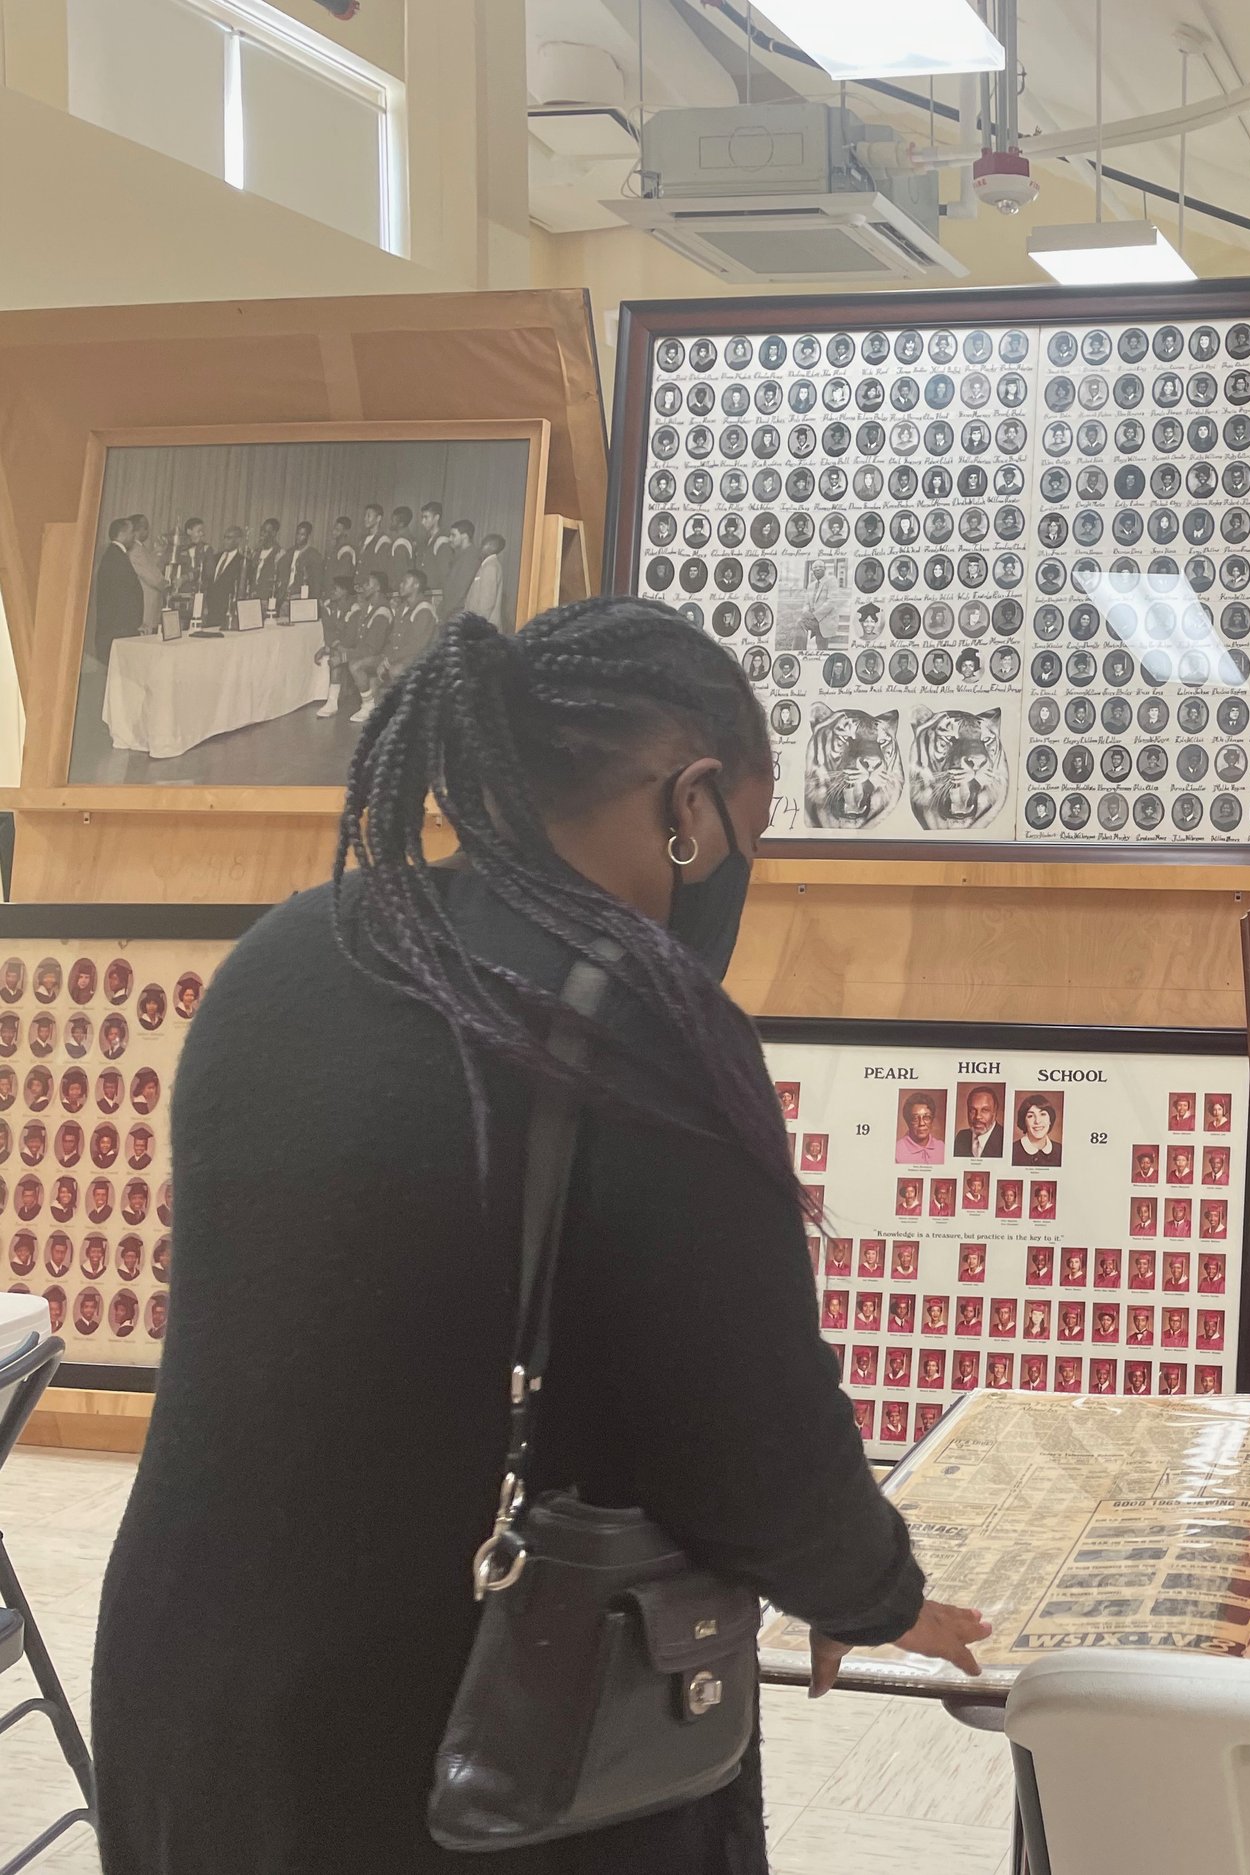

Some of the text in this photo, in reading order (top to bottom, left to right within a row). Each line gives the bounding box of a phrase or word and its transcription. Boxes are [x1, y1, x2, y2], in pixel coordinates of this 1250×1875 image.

[864, 1061, 1108, 1082] PEARL HIGH SCHOOL
[855, 1123, 1108, 1145] 19 82
[1029, 1234, 1041, 1242] key
[1113, 1500, 1147, 1509] GOOD
[909, 1523, 969, 1535] RNACE
